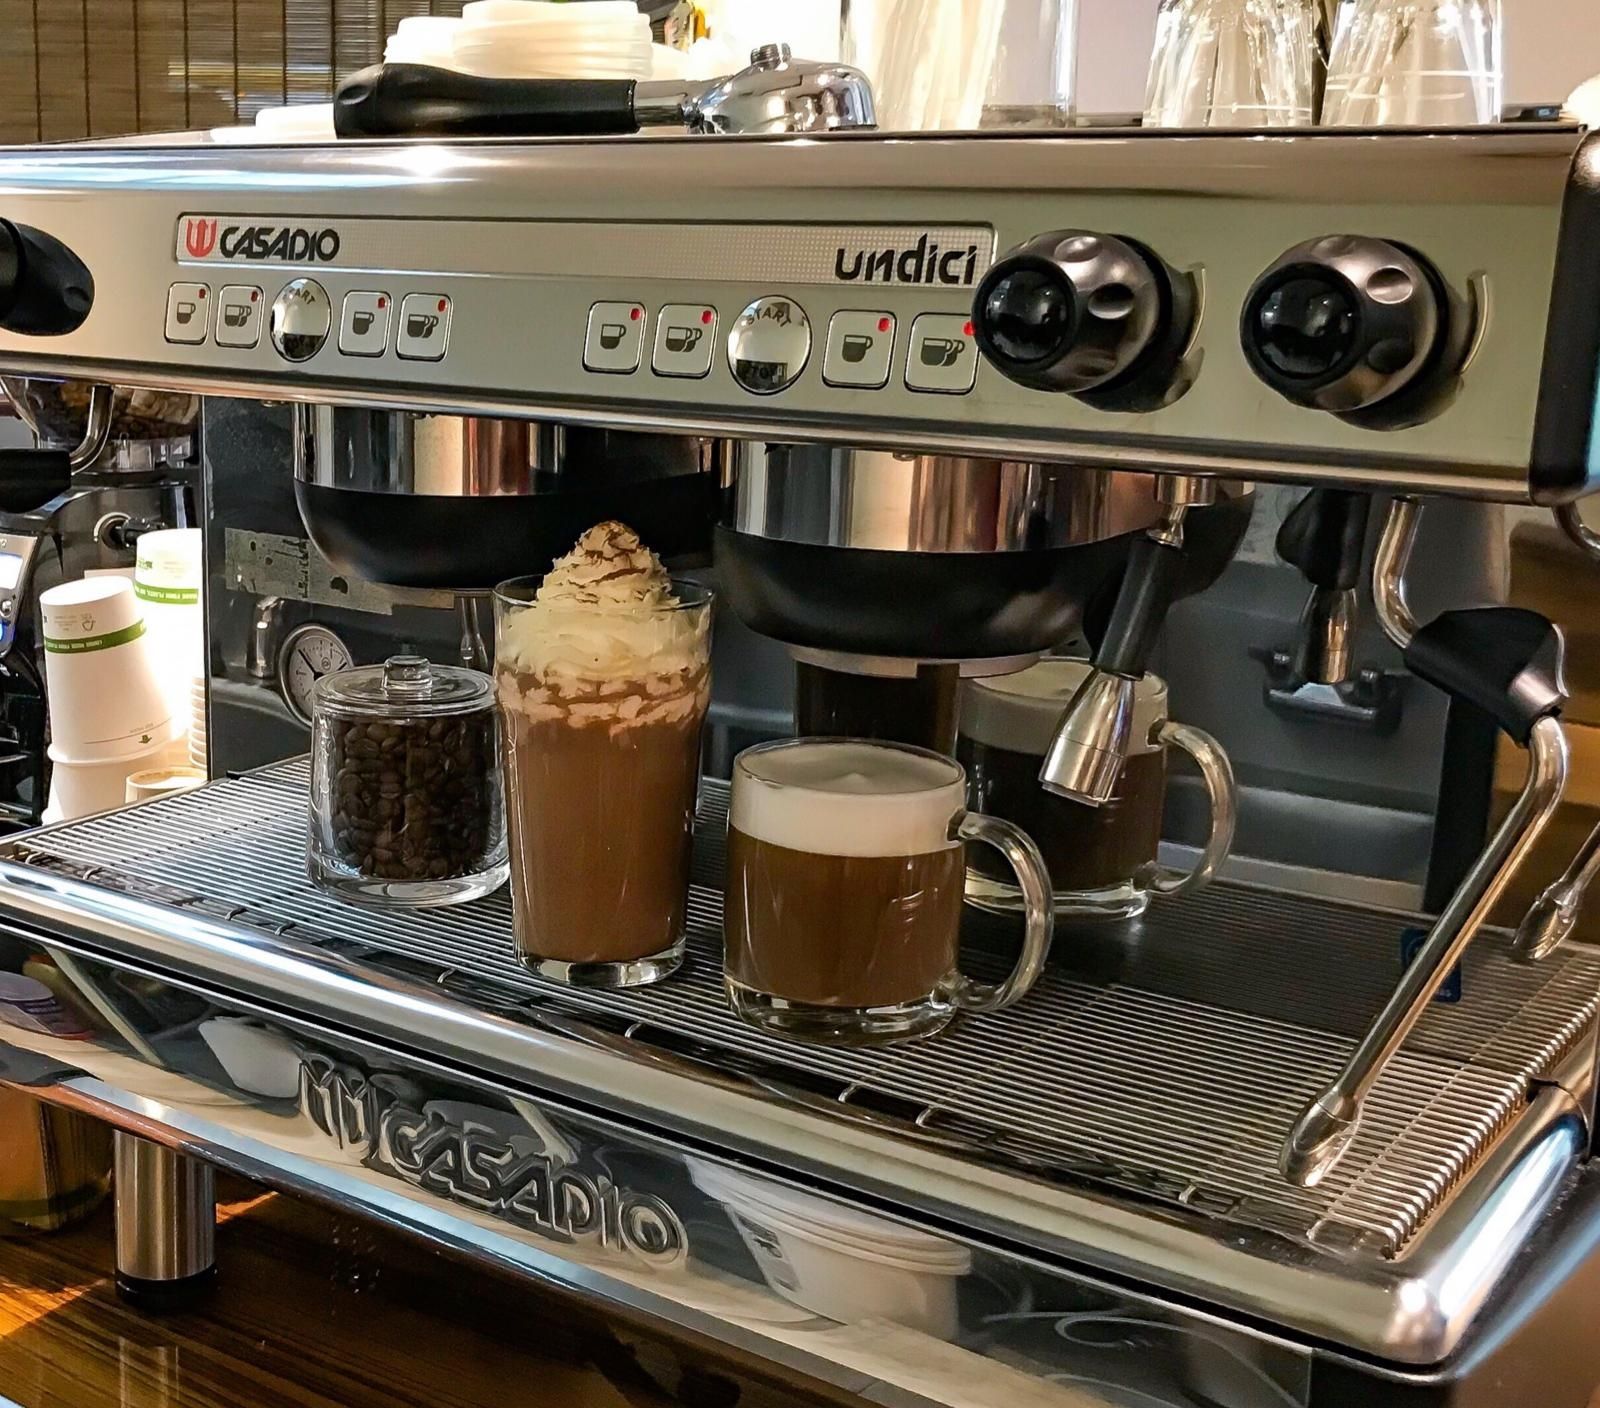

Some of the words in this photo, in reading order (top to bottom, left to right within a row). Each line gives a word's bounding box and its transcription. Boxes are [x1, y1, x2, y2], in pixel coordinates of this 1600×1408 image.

[219, 226, 341, 262] CASADIO
[834, 233, 978, 285] undici
[378, 1102, 690, 1268] CASADIO
